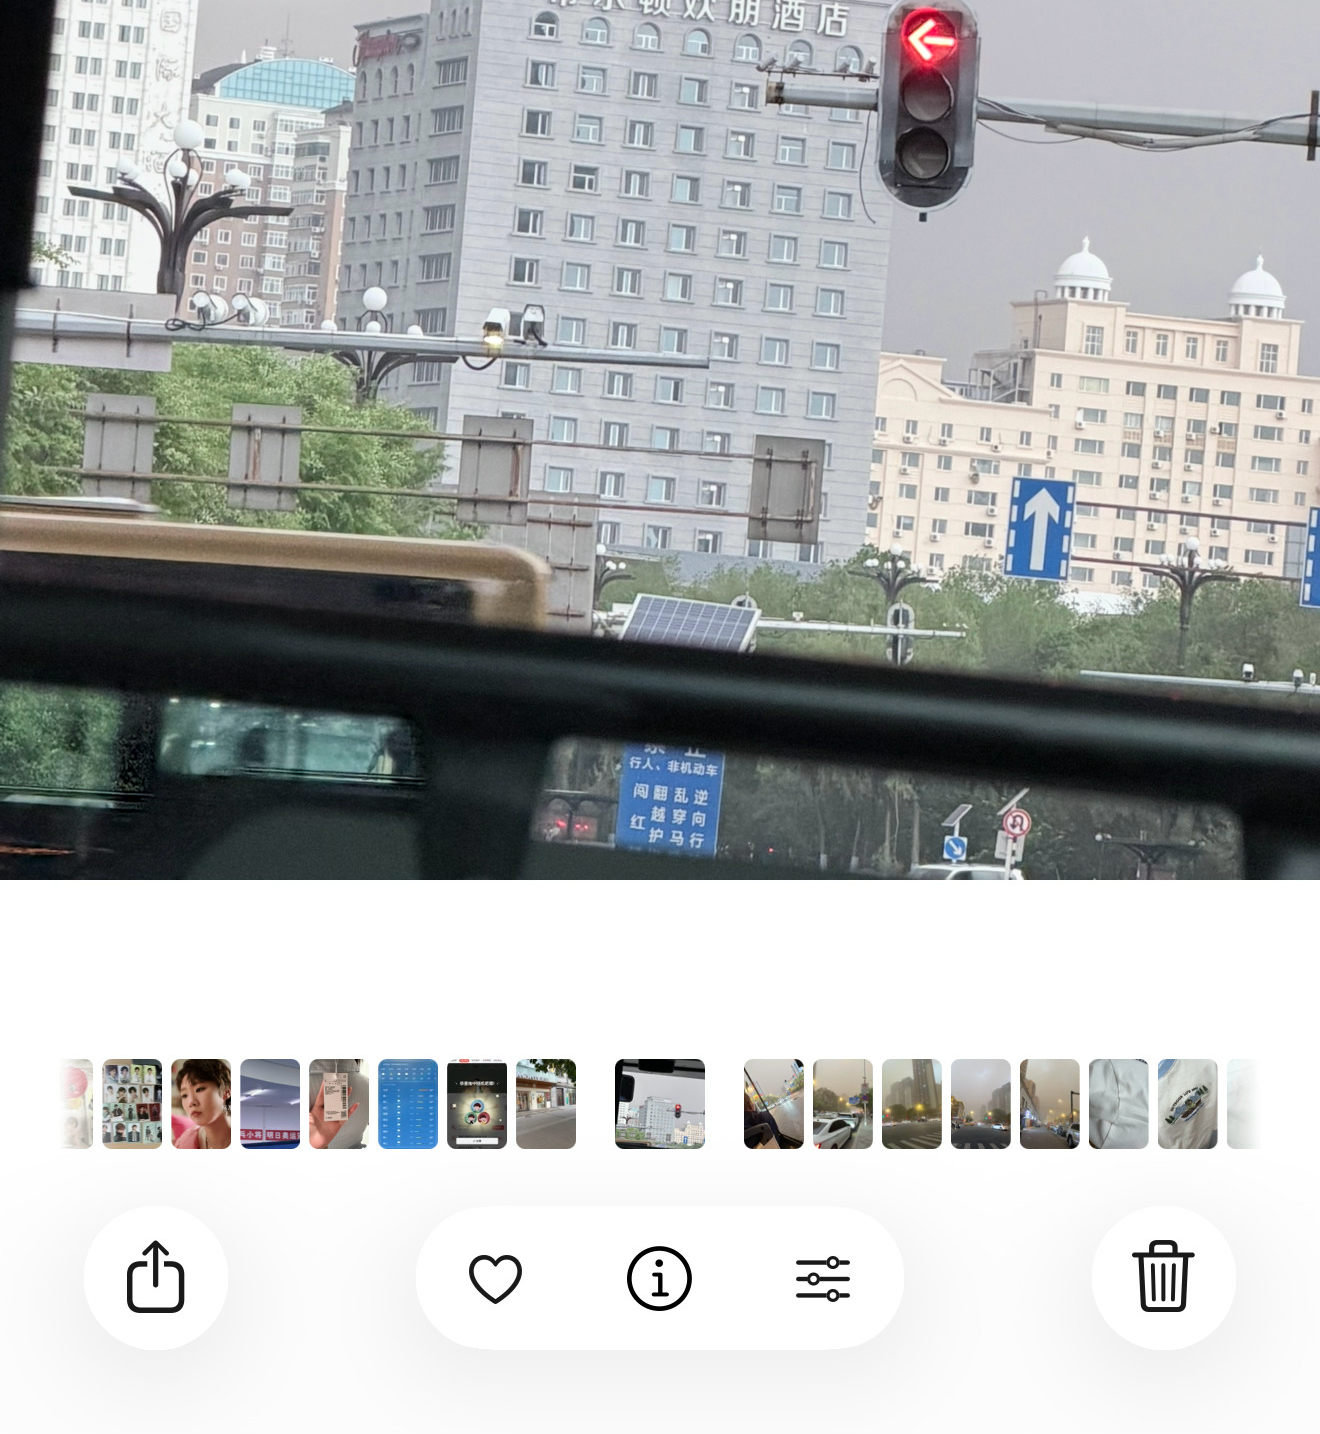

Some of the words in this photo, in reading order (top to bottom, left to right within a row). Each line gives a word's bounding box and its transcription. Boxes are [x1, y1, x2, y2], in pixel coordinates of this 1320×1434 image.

[629, 756, 719, 778] 行人、非机动车
